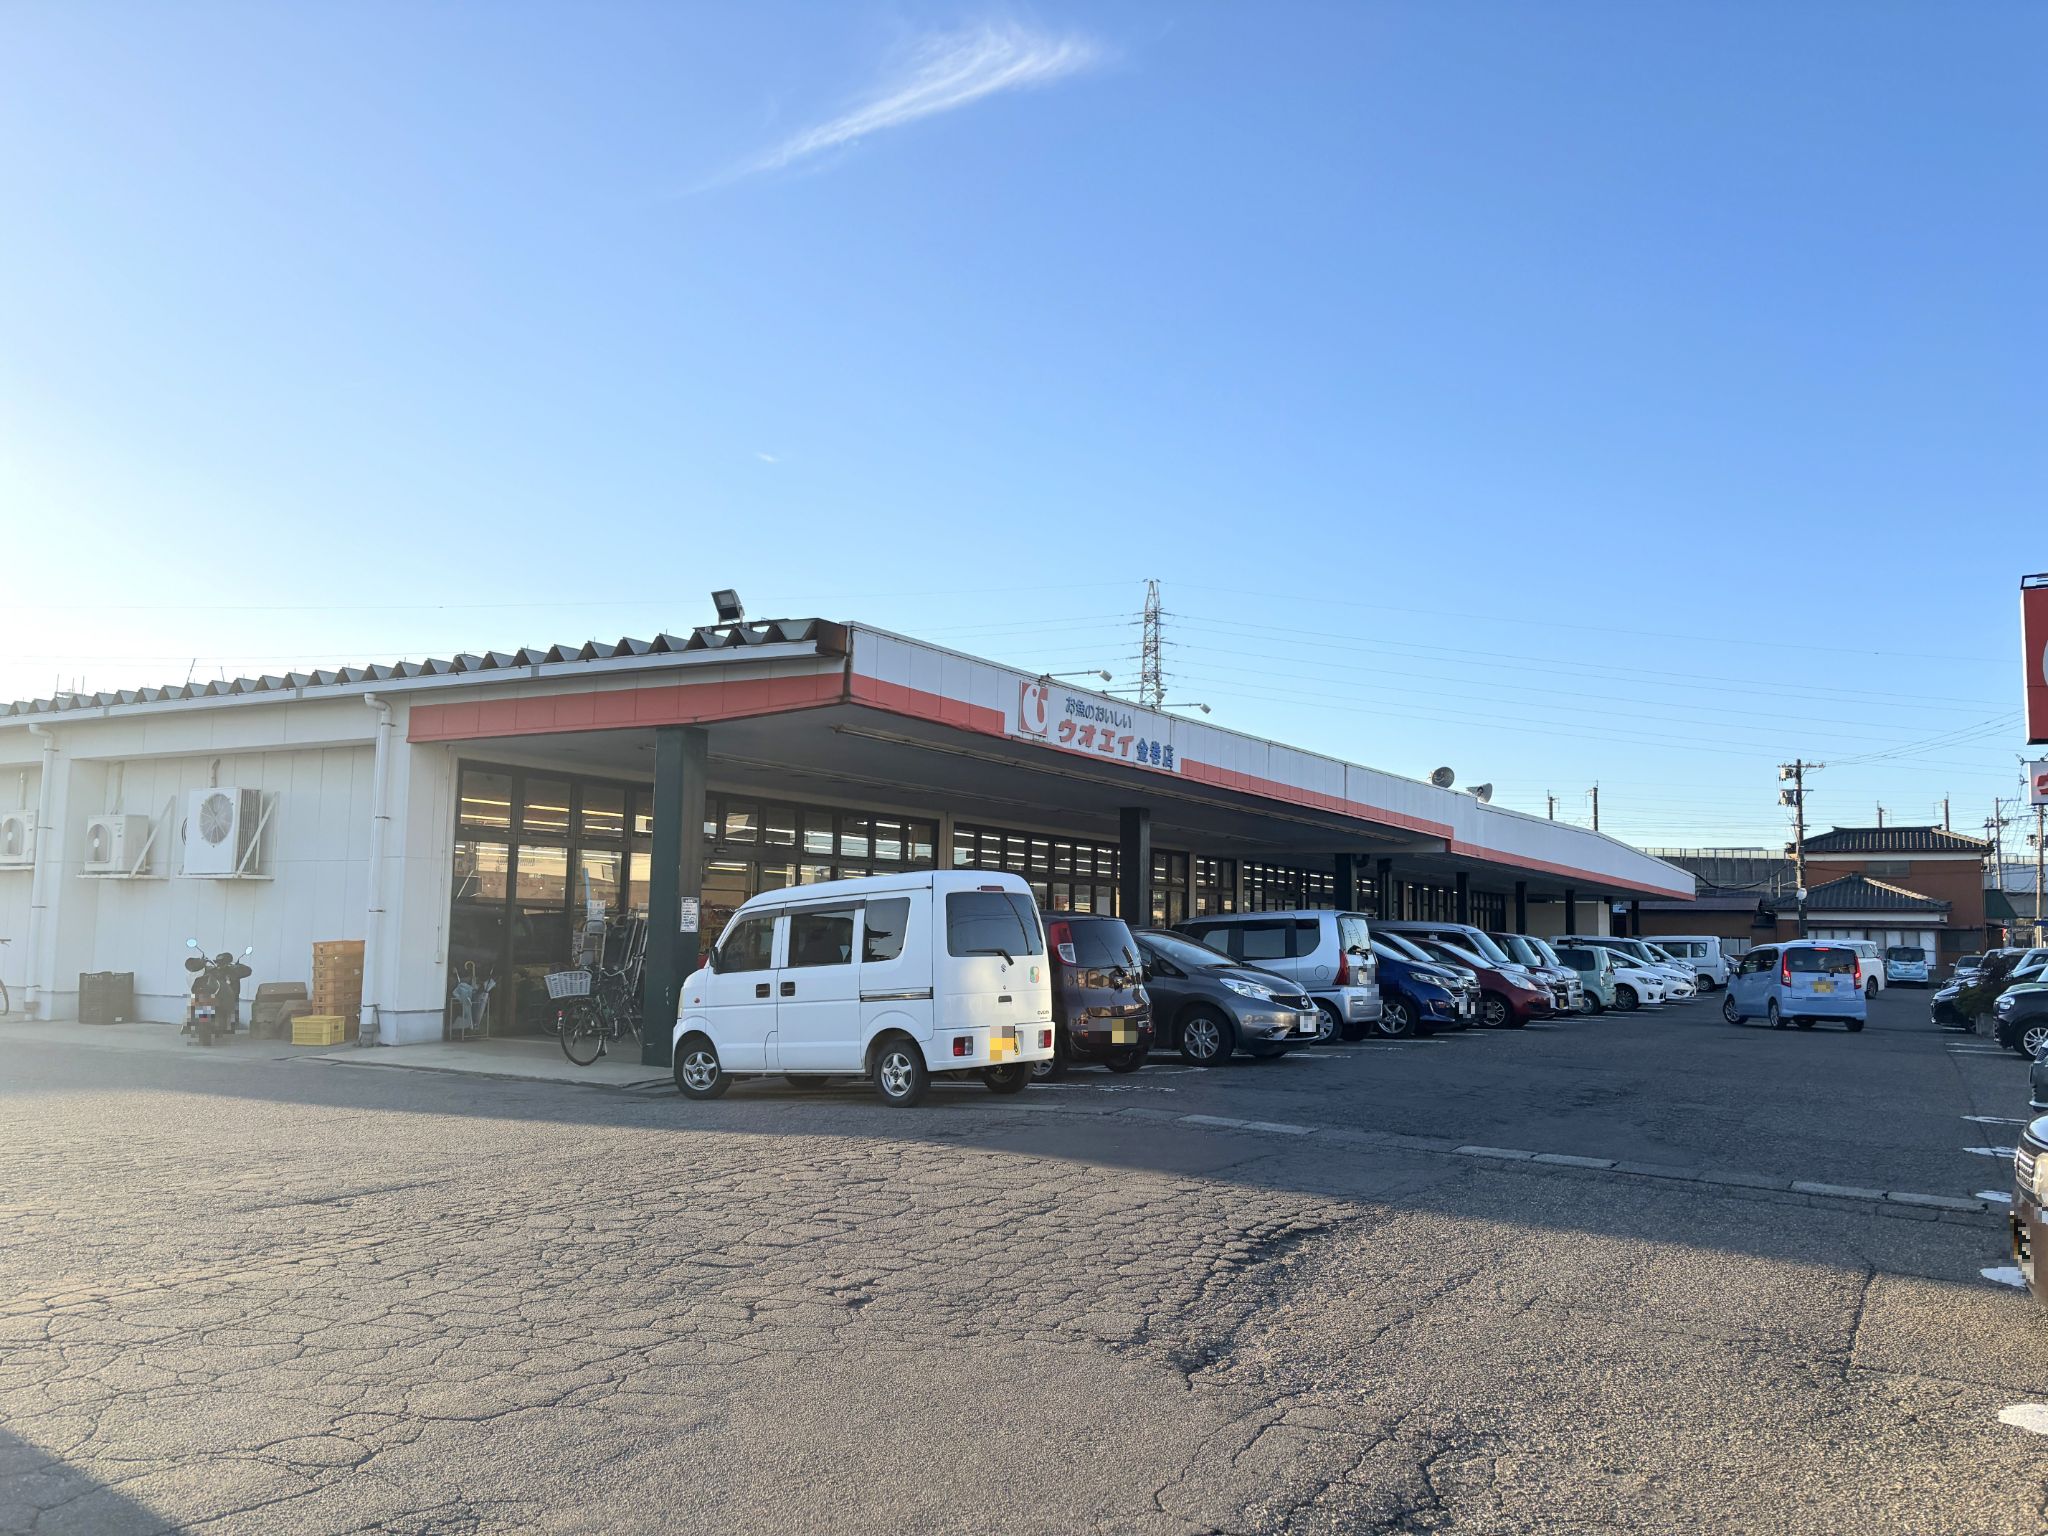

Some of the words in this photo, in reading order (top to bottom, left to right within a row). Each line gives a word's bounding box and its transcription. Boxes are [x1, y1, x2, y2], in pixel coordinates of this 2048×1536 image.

[1065, 696, 1131, 729] お魚のおいしい
[1058, 718, 1134, 756] ウオエイ
